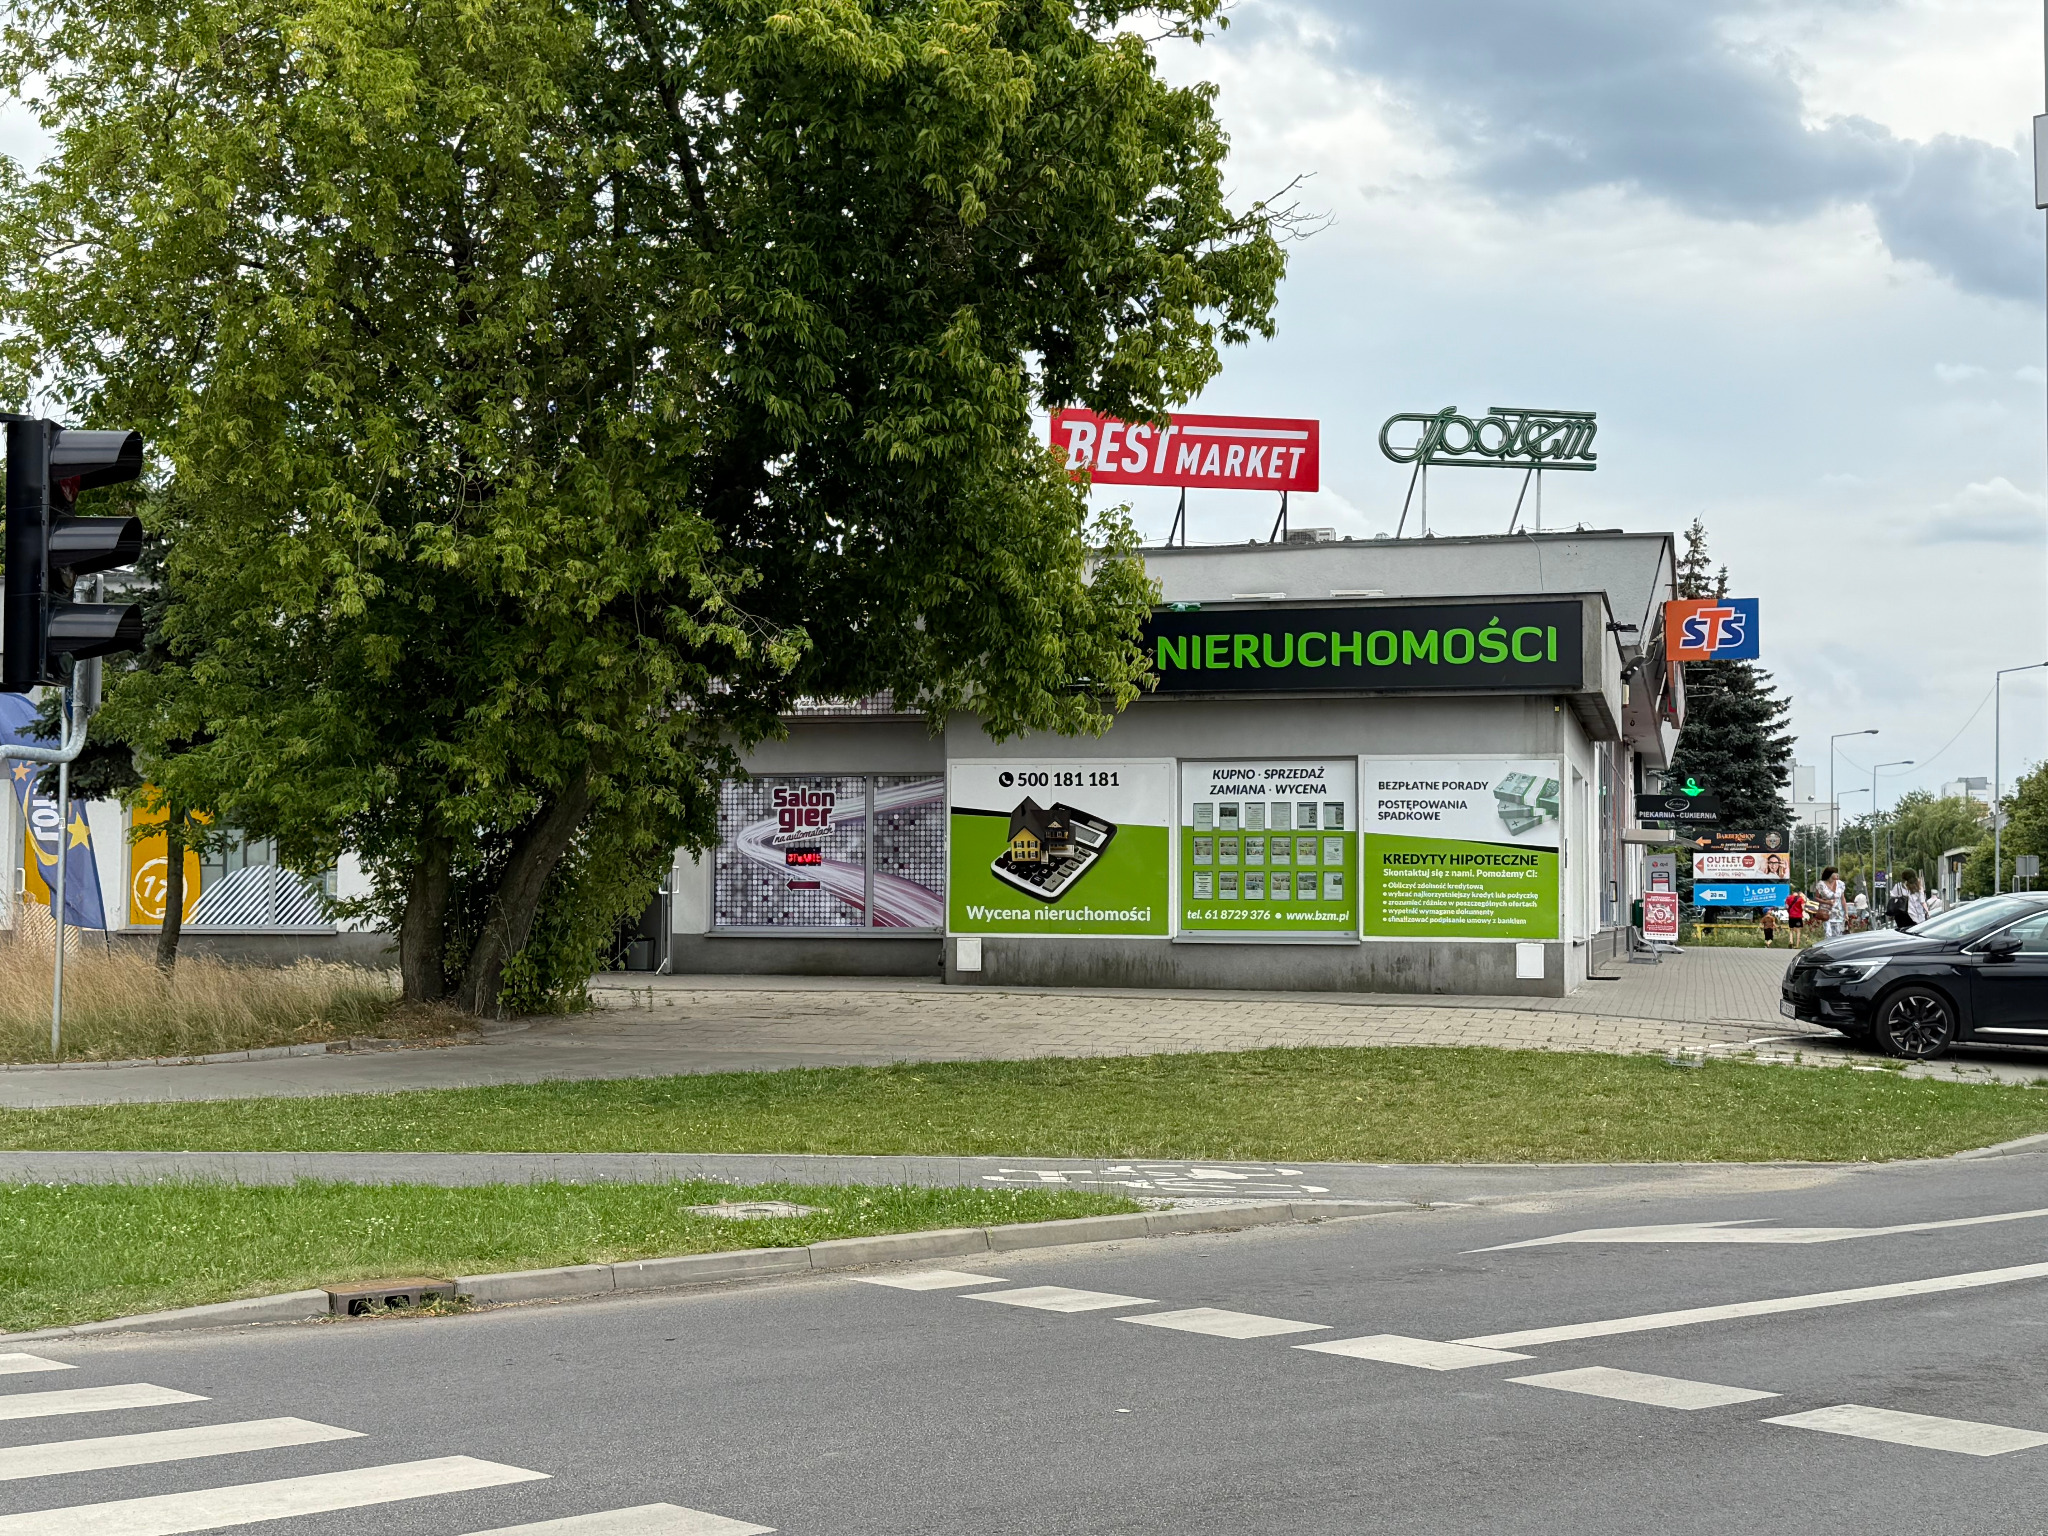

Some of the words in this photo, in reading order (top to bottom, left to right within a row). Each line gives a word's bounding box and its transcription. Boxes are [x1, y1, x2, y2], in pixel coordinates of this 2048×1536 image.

[1061, 420, 1179, 474] BEST
[1175, 443, 1306, 479] MARKET
[1679, 607, 1746, 651] STS
[1157, 616, 1558, 671] NIERUCHOMOŚCI
[1212, 769, 1255, 780] KUPNO
[1264, 766, 1325, 779] SPRZEDAŻ
[1017, 772, 1049, 787] 500
[1053, 772, 1084, 787] 181
[1089, 772, 1119, 787] 181
[1210, 784, 1266, 795] ZAMIANA
[1275, 784, 1327, 794] WYCENA
[1378, 781, 1439, 791] BEZPŁATNE
[1442, 781, 1488, 790] PORADY
[773, 788, 835, 807] Salon
[1378, 800, 1468, 811] POSTĘPOWANIA
[778, 808, 833, 833] gier
[1378, 811, 1441, 821] SPADKOWE
[1383, 854, 1446, 865] KREDYTY
[1450, 854, 1539, 866] HIPOTECZNE
[1706, 856, 1741, 864] OUTLET
[1383, 869, 1430, 878] Skontaktuj
[1431, 869, 1443, 878] się
[1451, 869, 1474, 877] nami.
[1476, 869, 1524, 879] Pomożemy
[1413, 891, 1470, 899] najkorzystniejszy
[1507, 892, 1539, 900] pożyczkę
[1752, 887, 1776, 895] LODY
[1455, 900, 1508, 908] poszczególnych
[966, 905, 1030, 922] Wycena
[1034, 906, 1151, 922] nieruchomości
[1187, 909, 1203, 919] tel.
[1205, 910, 1218, 920] 61
[1220, 910, 1248, 920] 8729
[1250, 910, 1271, 920] 376
[1286, 911, 1349, 922] www.bzm.pl
[1456, 908, 1494, 916] dokumenty
